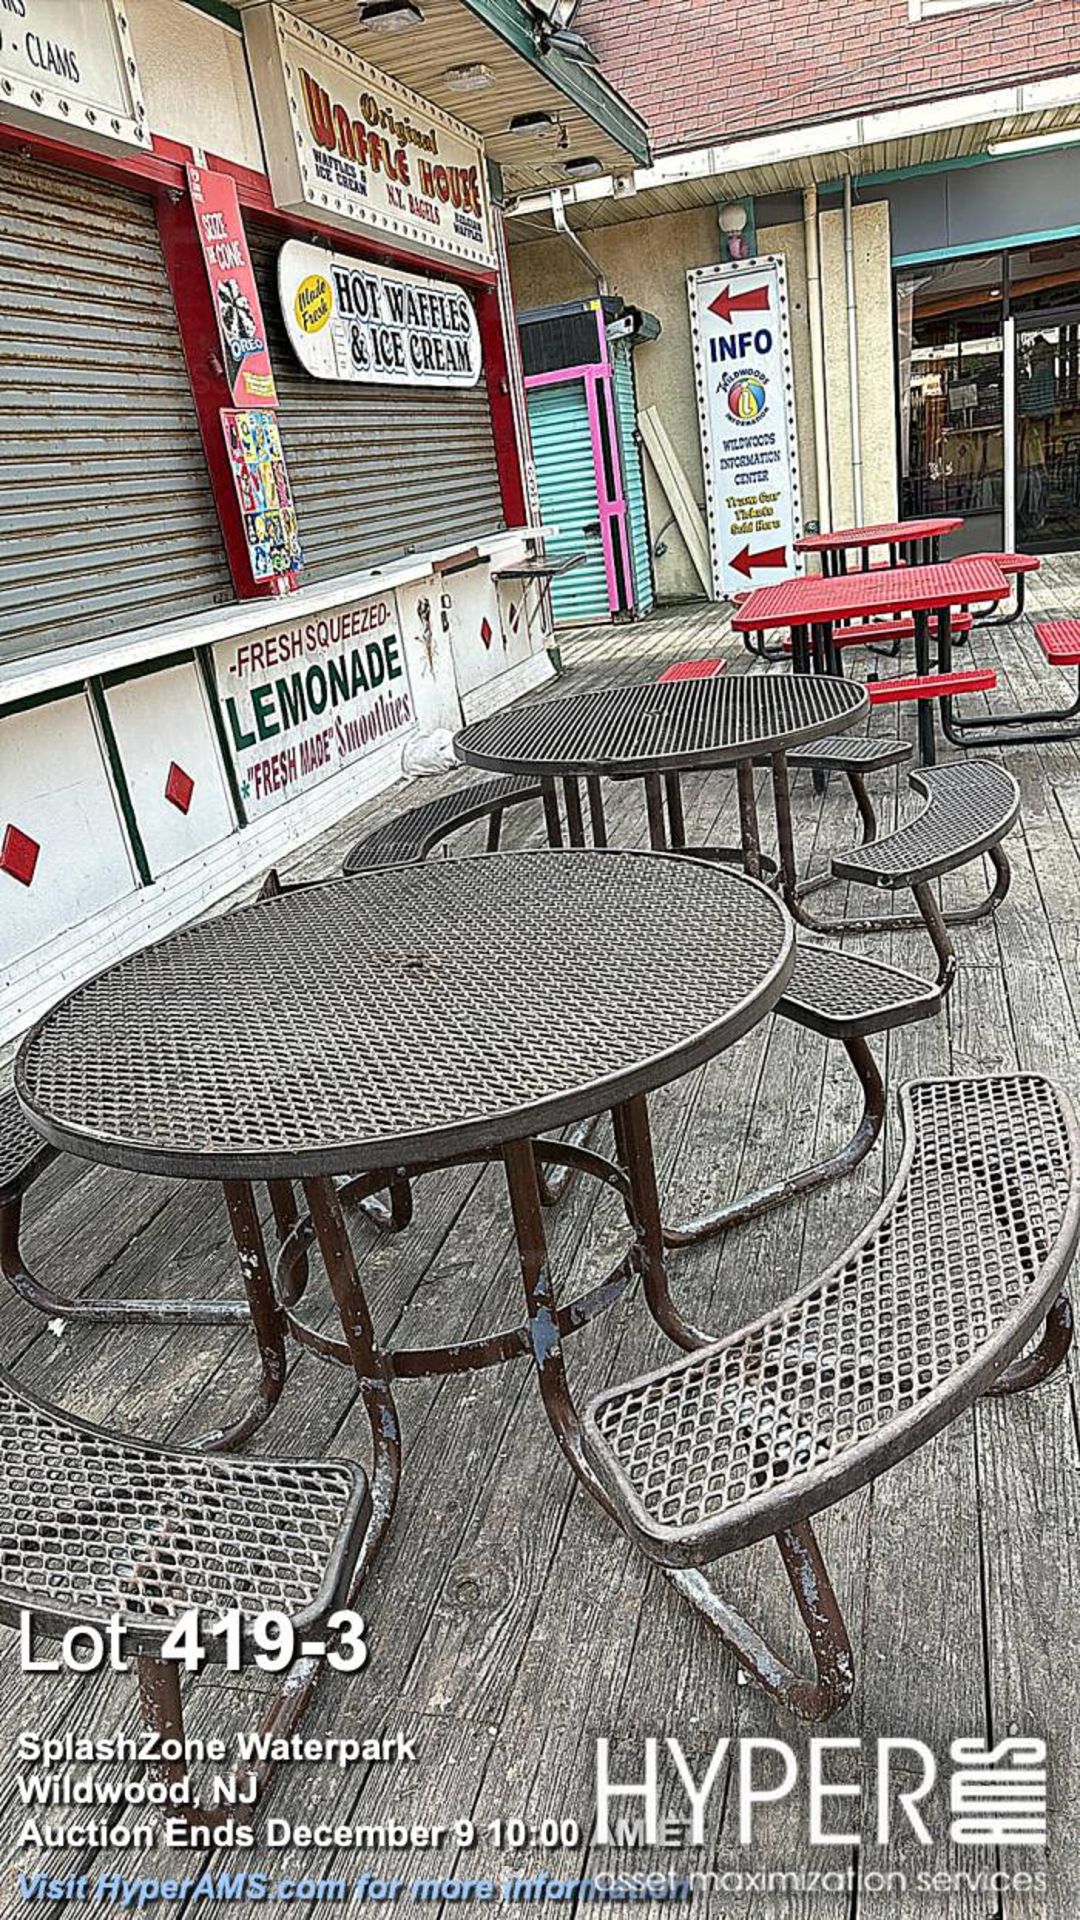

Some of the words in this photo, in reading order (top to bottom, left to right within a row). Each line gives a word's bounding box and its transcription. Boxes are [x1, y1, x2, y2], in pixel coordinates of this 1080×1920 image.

[26, 32, 79, 83] CLAMS
[360, 93, 438, 155] Original
[299, 67, 411, 187] WAFFLE
[418, 158, 481, 219] HOUSE
[312, 148, 357, 179] WAFFLES
[314, 163, 333, 183] ICE
[336, 172, 368, 197] CREAM
[407, 193, 440, 226] BAGELS
[298, 279, 326, 312] Made
[333, 272, 380, 319] HOT
[384, 284, 470, 334] WAFFLES
[301, 298, 328, 331] Fresh
[231, 338, 264, 360] OREO
[351, 325, 369, 365] &
[371, 328, 405, 367] ICE
[410, 334, 472, 373] CREAM
[709, 328, 772, 363] INFO
[716, 368, 770, 394] WILDWOODS
[722, 432, 776, 453] WILDWOODS
[720, 450, 781, 471] INFORMATION
[734, 470, 769, 486] CENTER
[225, 634, 402, 752] LEMONADE
[334, 690, 412, 758] Smoothies
